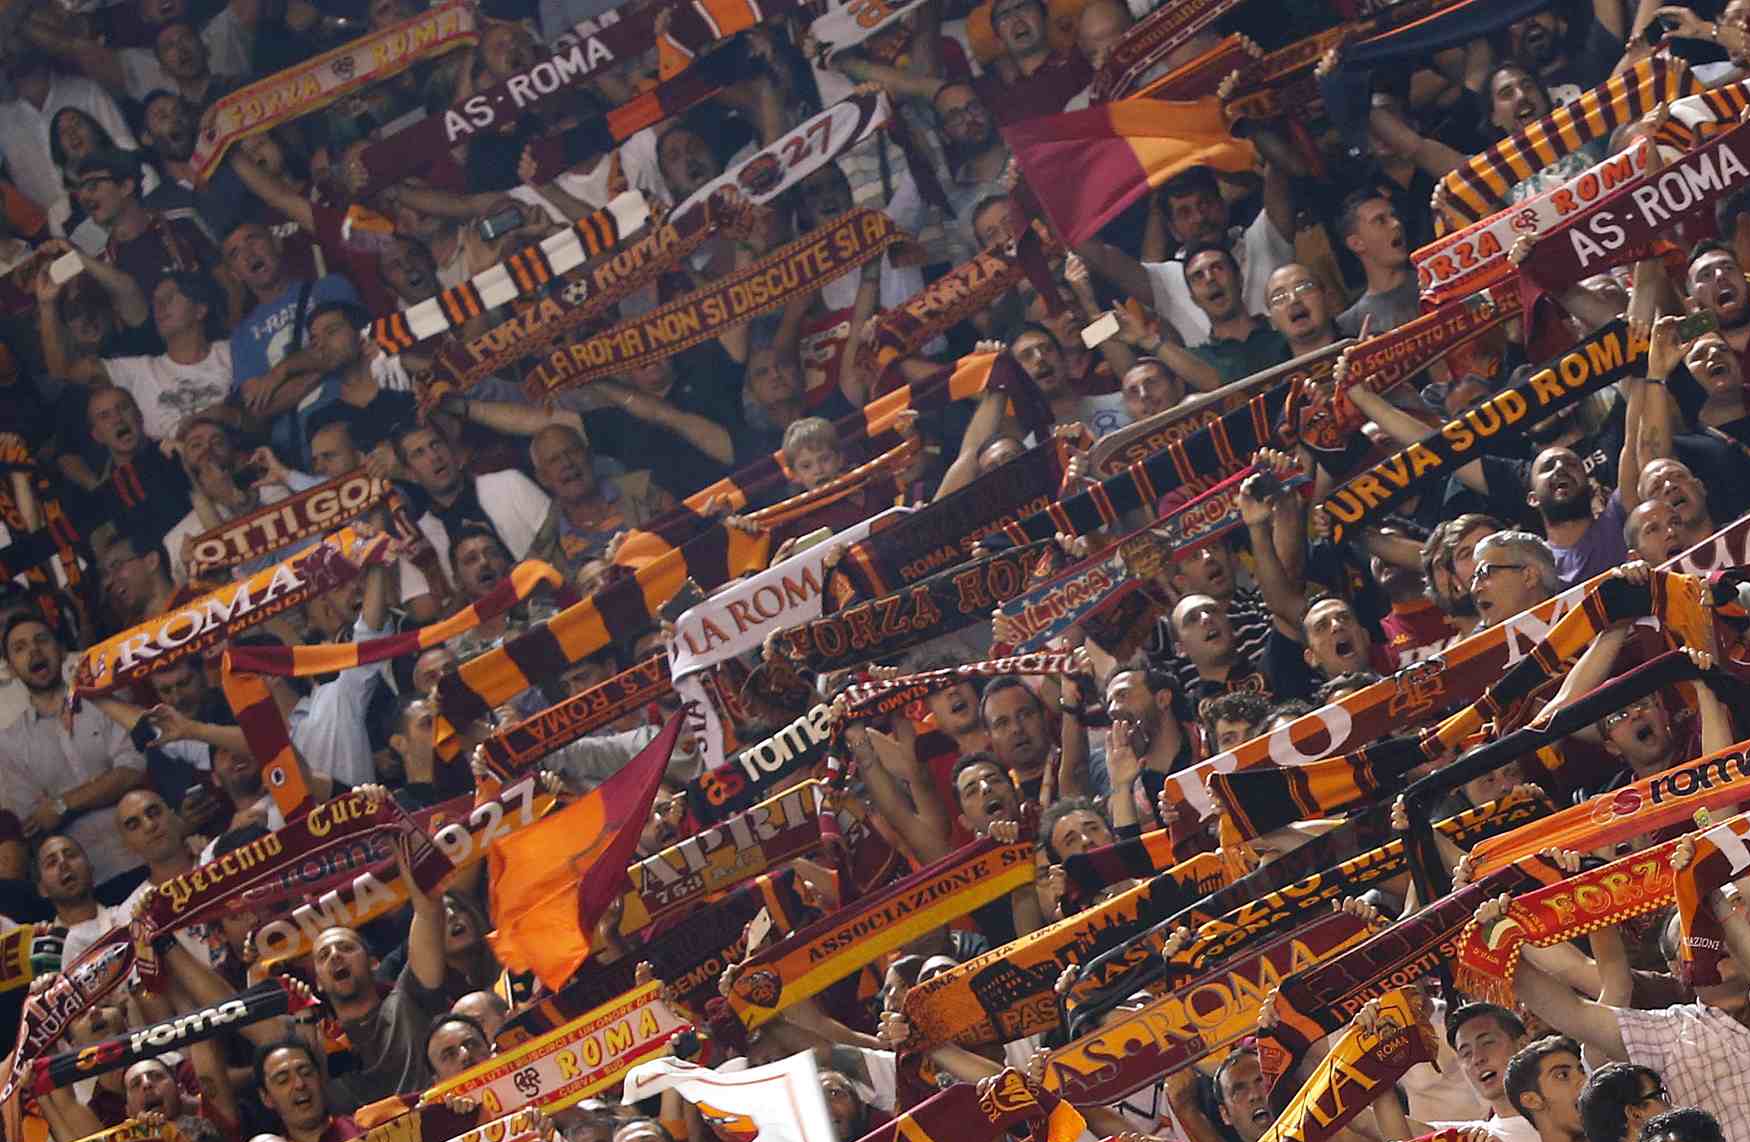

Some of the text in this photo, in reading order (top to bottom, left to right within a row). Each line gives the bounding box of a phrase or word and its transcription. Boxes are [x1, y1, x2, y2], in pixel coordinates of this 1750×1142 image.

[371, 15, 464, 66] ROMA
[507, 36, 615, 108] ROMA
[1568, 144, 1750, 268] AS ROMA
[571, 330, 644, 379] ROMA
[645, 311, 700, 354] NON
[701, 300, 729, 326] SI
[731, 252, 834, 314] DISCUTE
[833, 232, 862, 264] SI
[905, 249, 1007, 324] FORZA
[465, 301, 567, 364] FORZA
[1441, 387, 1529, 453] SUD
[1528, 325, 1653, 407] ROMA
[115, 561, 307, 673] ROMA
[739, 701, 834, 783] roma
[806, 860, 992, 967] ASSOCIAZIONE
[1380, 951, 1441, 994] FORTI
[129, 999, 249, 1054] roma
[553, 1007, 659, 1082] ROMA
